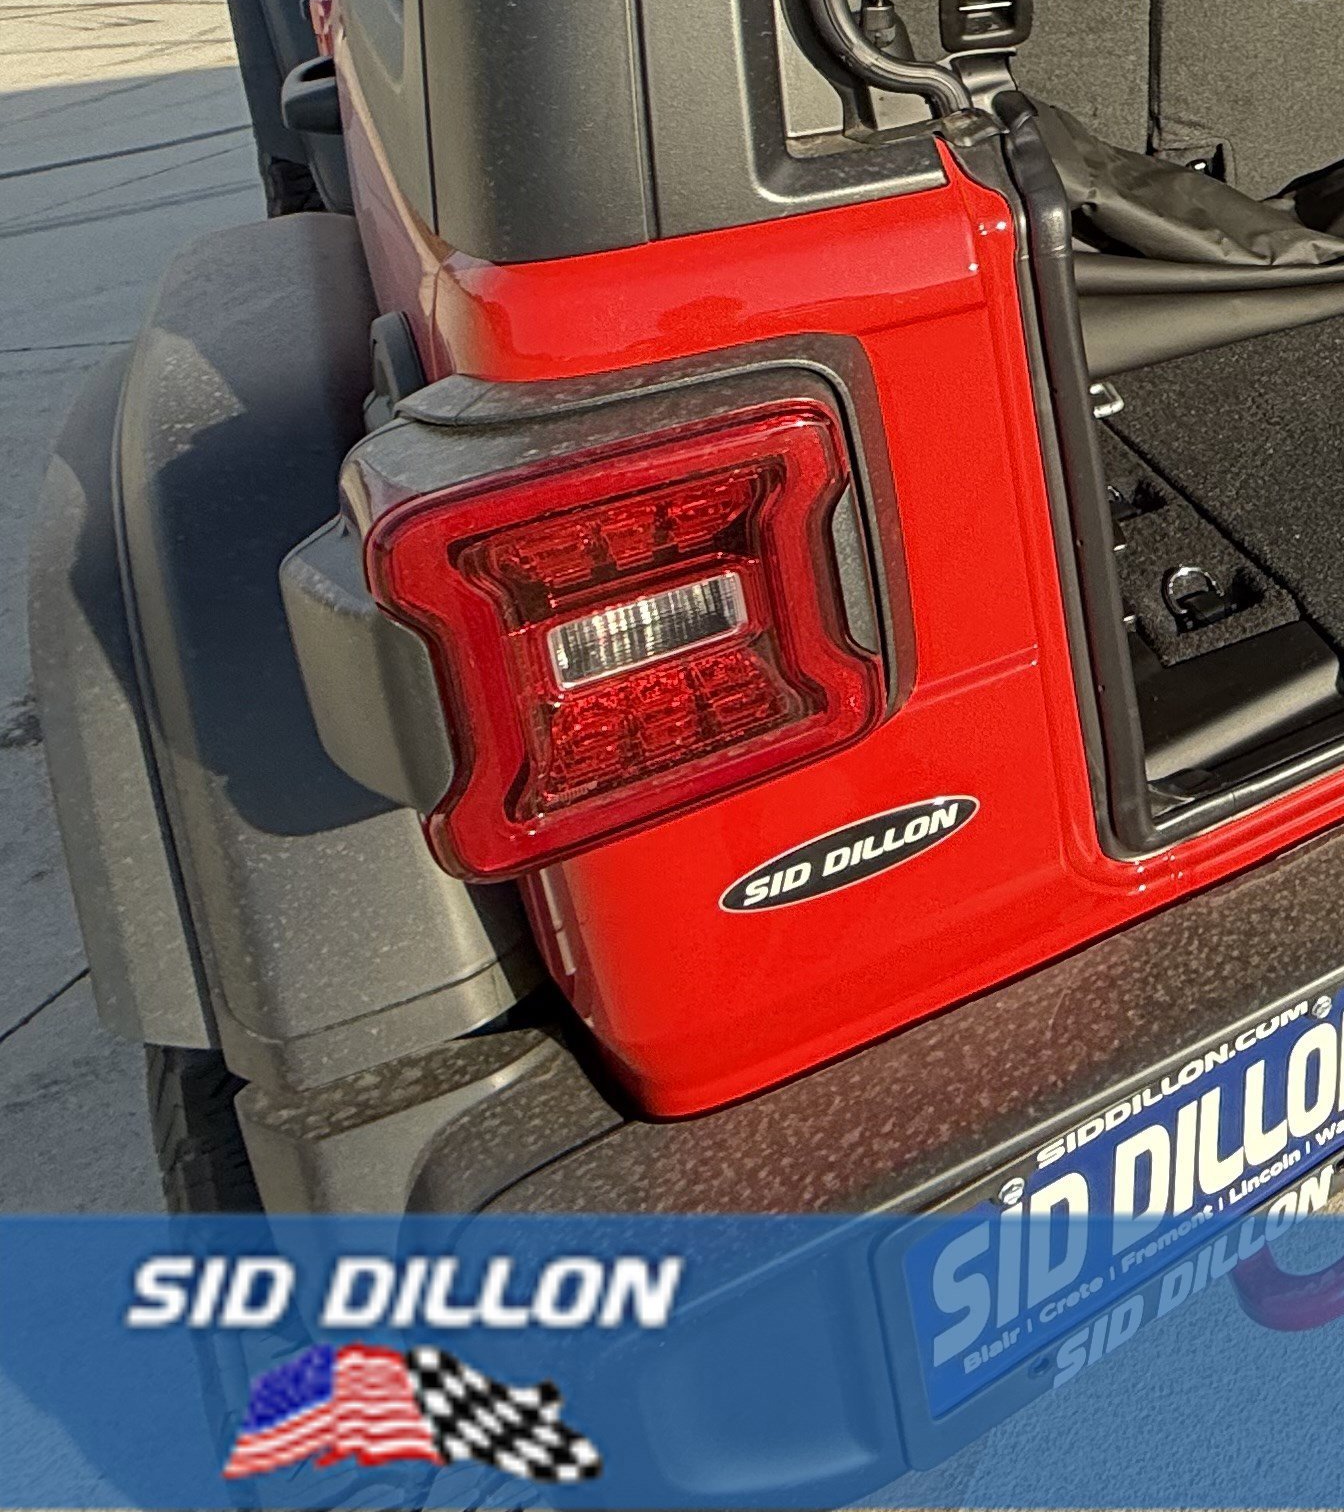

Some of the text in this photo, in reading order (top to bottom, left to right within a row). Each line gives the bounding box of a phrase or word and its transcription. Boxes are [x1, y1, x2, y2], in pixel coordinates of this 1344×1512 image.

[743, 803, 959, 907] SID DILLON
[1036, 1000, 1309, 1170] SIDDILLON.COM
[933, 1171, 1090, 1368] SID
[964, 1326, 1020, 1375] Blair
[1039, 1276, 1105, 1324] Crete
[1121, 1204, 1215, 1276] Fremont
[1228, 1148, 1302, 1209] Lincoln
[1051, 1163, 1334, 1391] SID DILLON
